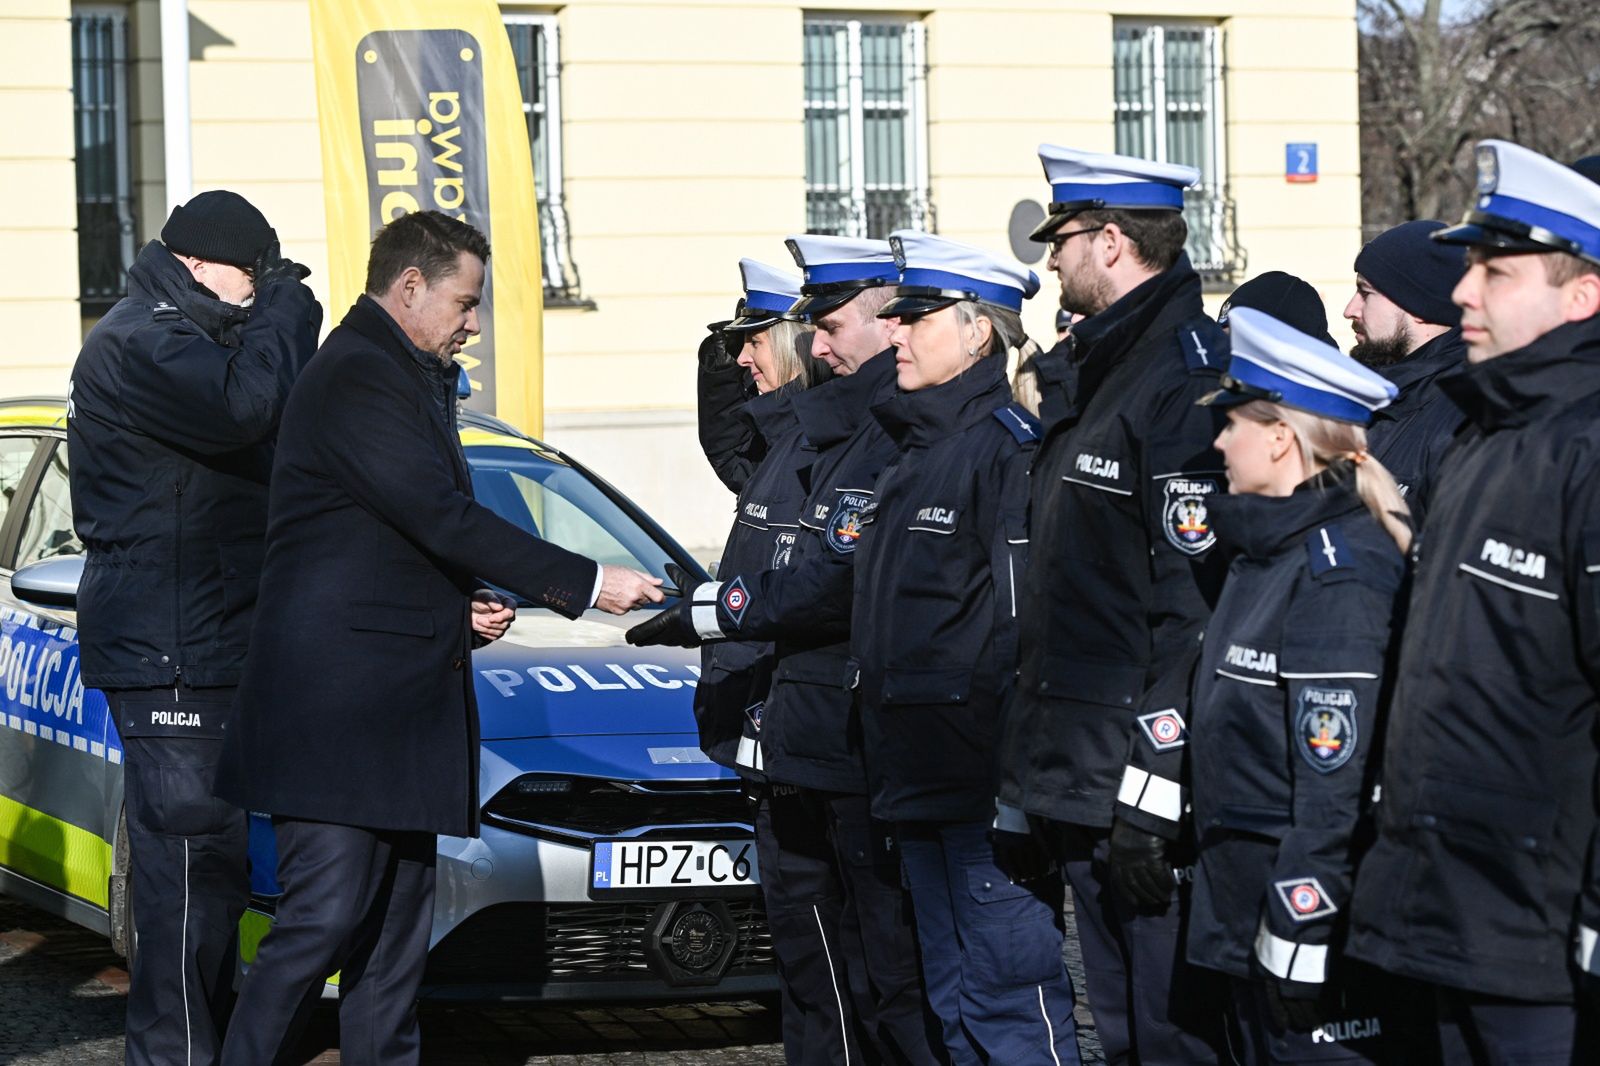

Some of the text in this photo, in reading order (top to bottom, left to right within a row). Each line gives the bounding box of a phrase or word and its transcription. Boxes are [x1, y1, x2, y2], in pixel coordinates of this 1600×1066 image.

[1297, 150, 1309, 174] 2
[1076, 454, 1119, 480] POLCJA
[843, 496, 867, 508] POLIC
[1480, 538, 1546, 579] POLCJA
[0, 635, 85, 725] POLICJA
[151, 711, 201, 727] POLICJA
[595, 871, 609, 882] PL
[620, 844, 751, 885] HPZ C6
[1312, 1017, 1381, 1043] POLICJA
